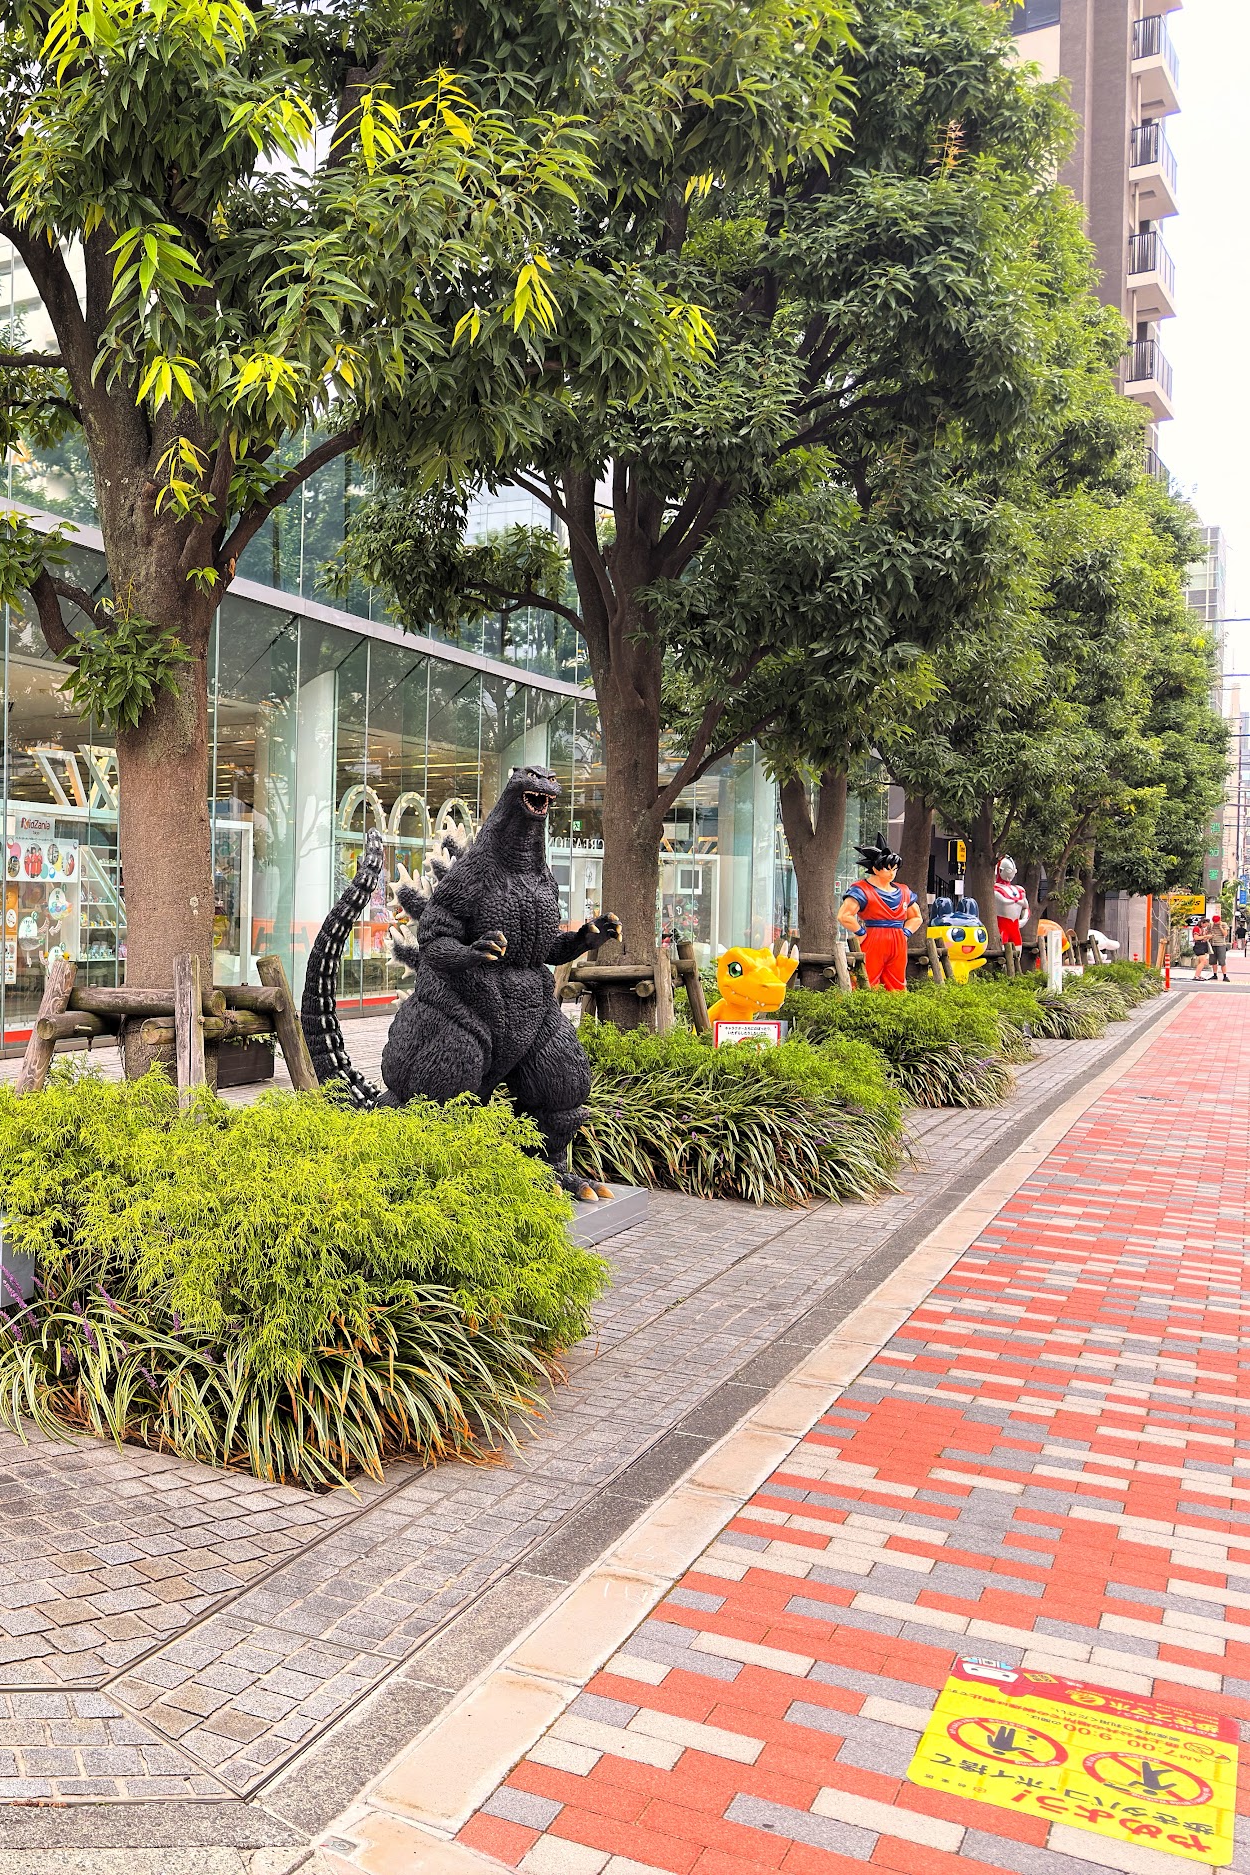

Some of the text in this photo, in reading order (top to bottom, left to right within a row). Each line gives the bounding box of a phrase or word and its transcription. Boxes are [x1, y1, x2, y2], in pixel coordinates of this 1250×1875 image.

[1108, 1699, 1219, 1734] 歩きスマホ
[928, 1751, 1215, 1838] 歩きタバコ・ポイ捨て
[1009, 1785, 1211, 1854] やめよう!
